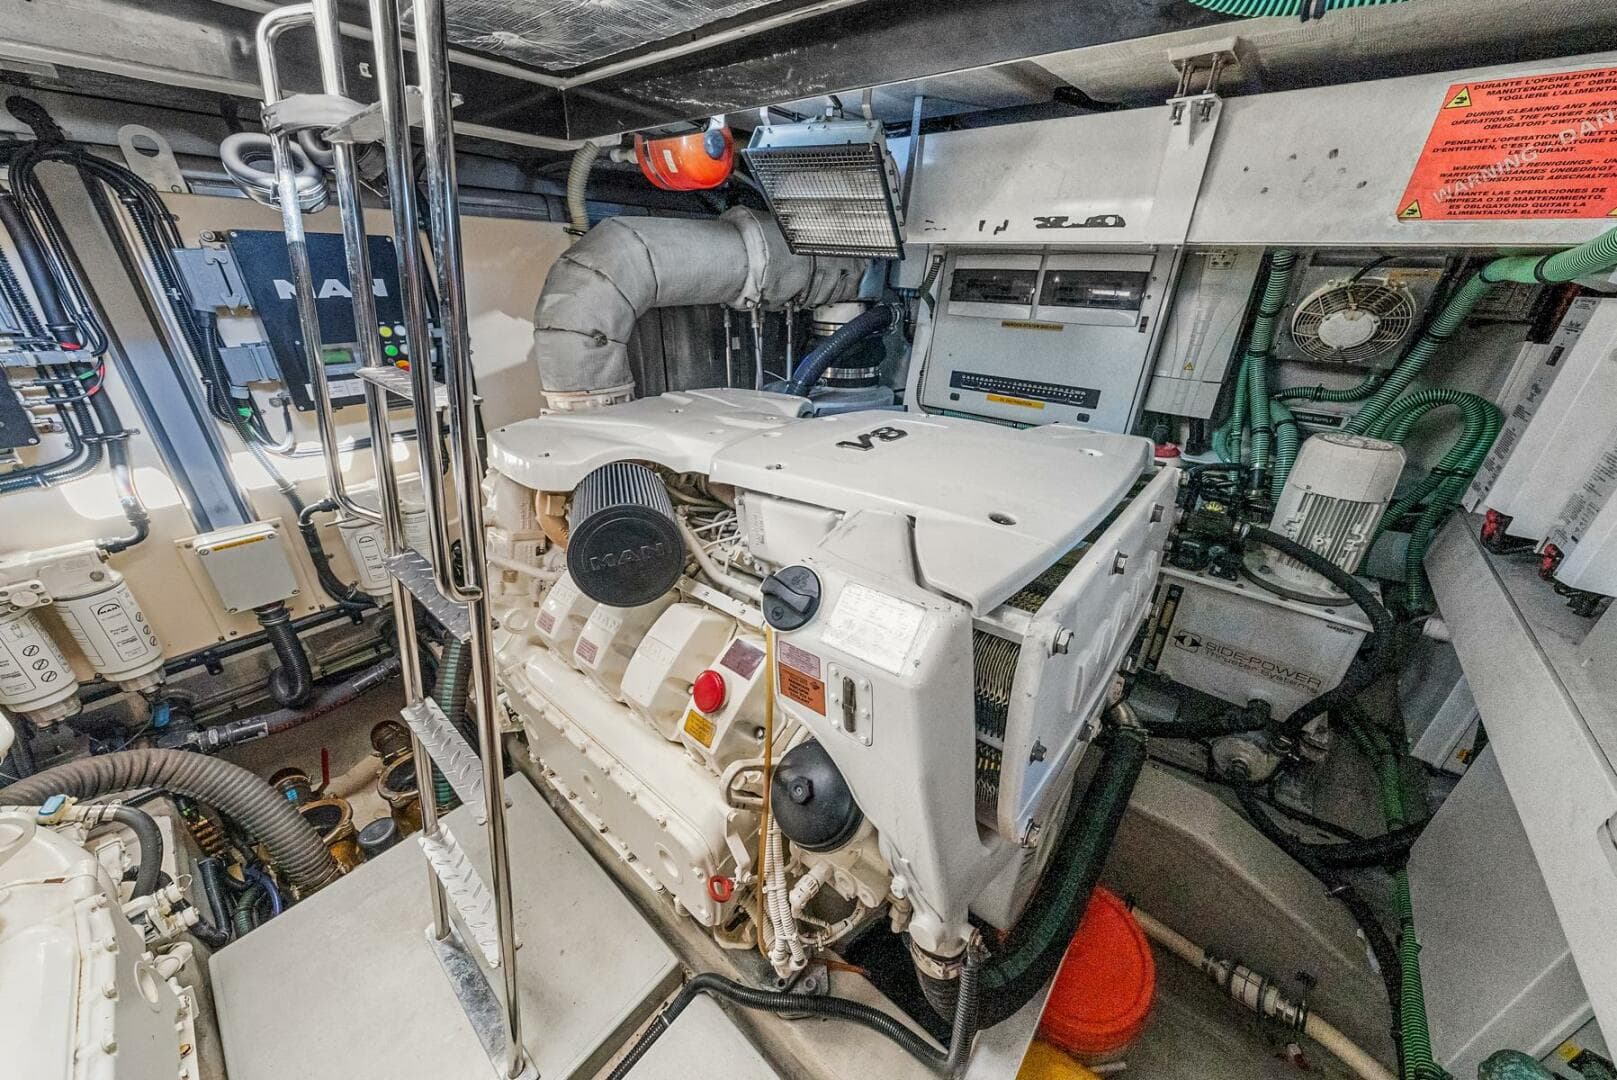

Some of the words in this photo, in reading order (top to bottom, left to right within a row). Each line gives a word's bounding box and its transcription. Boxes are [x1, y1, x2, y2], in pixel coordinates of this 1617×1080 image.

[1474, 80, 1523, 91] DURANTE
[1525, 71, 1606, 85] L'OPERAZIONE
[1486, 83, 1570, 96] MANUTENZIONE
[1498, 91, 1549, 102] TOGLIERE
[1465, 108, 1504, 118] DURING
[1507, 104, 1560, 115] CLEANING
[1563, 101, 1587, 109] AND
[1542, 110, 1583, 119] POWER
[1483, 120, 1549, 130] OBLIGATORY
[1444, 136, 1490, 146] PENDANT
[1492, 133, 1560, 143] L'OPERATION
[1500, 141, 1530, 150] C'EST
[1526, 158, 1593, 168] REINIGUNGS
[1549, 165, 1614, 174] UNBEDINGT
[836, 426, 908, 451] V8
[590, 542, 663, 572] MAN
[100, 606, 118, 616] MAN
[1205, 650, 1258, 672] Thruster
